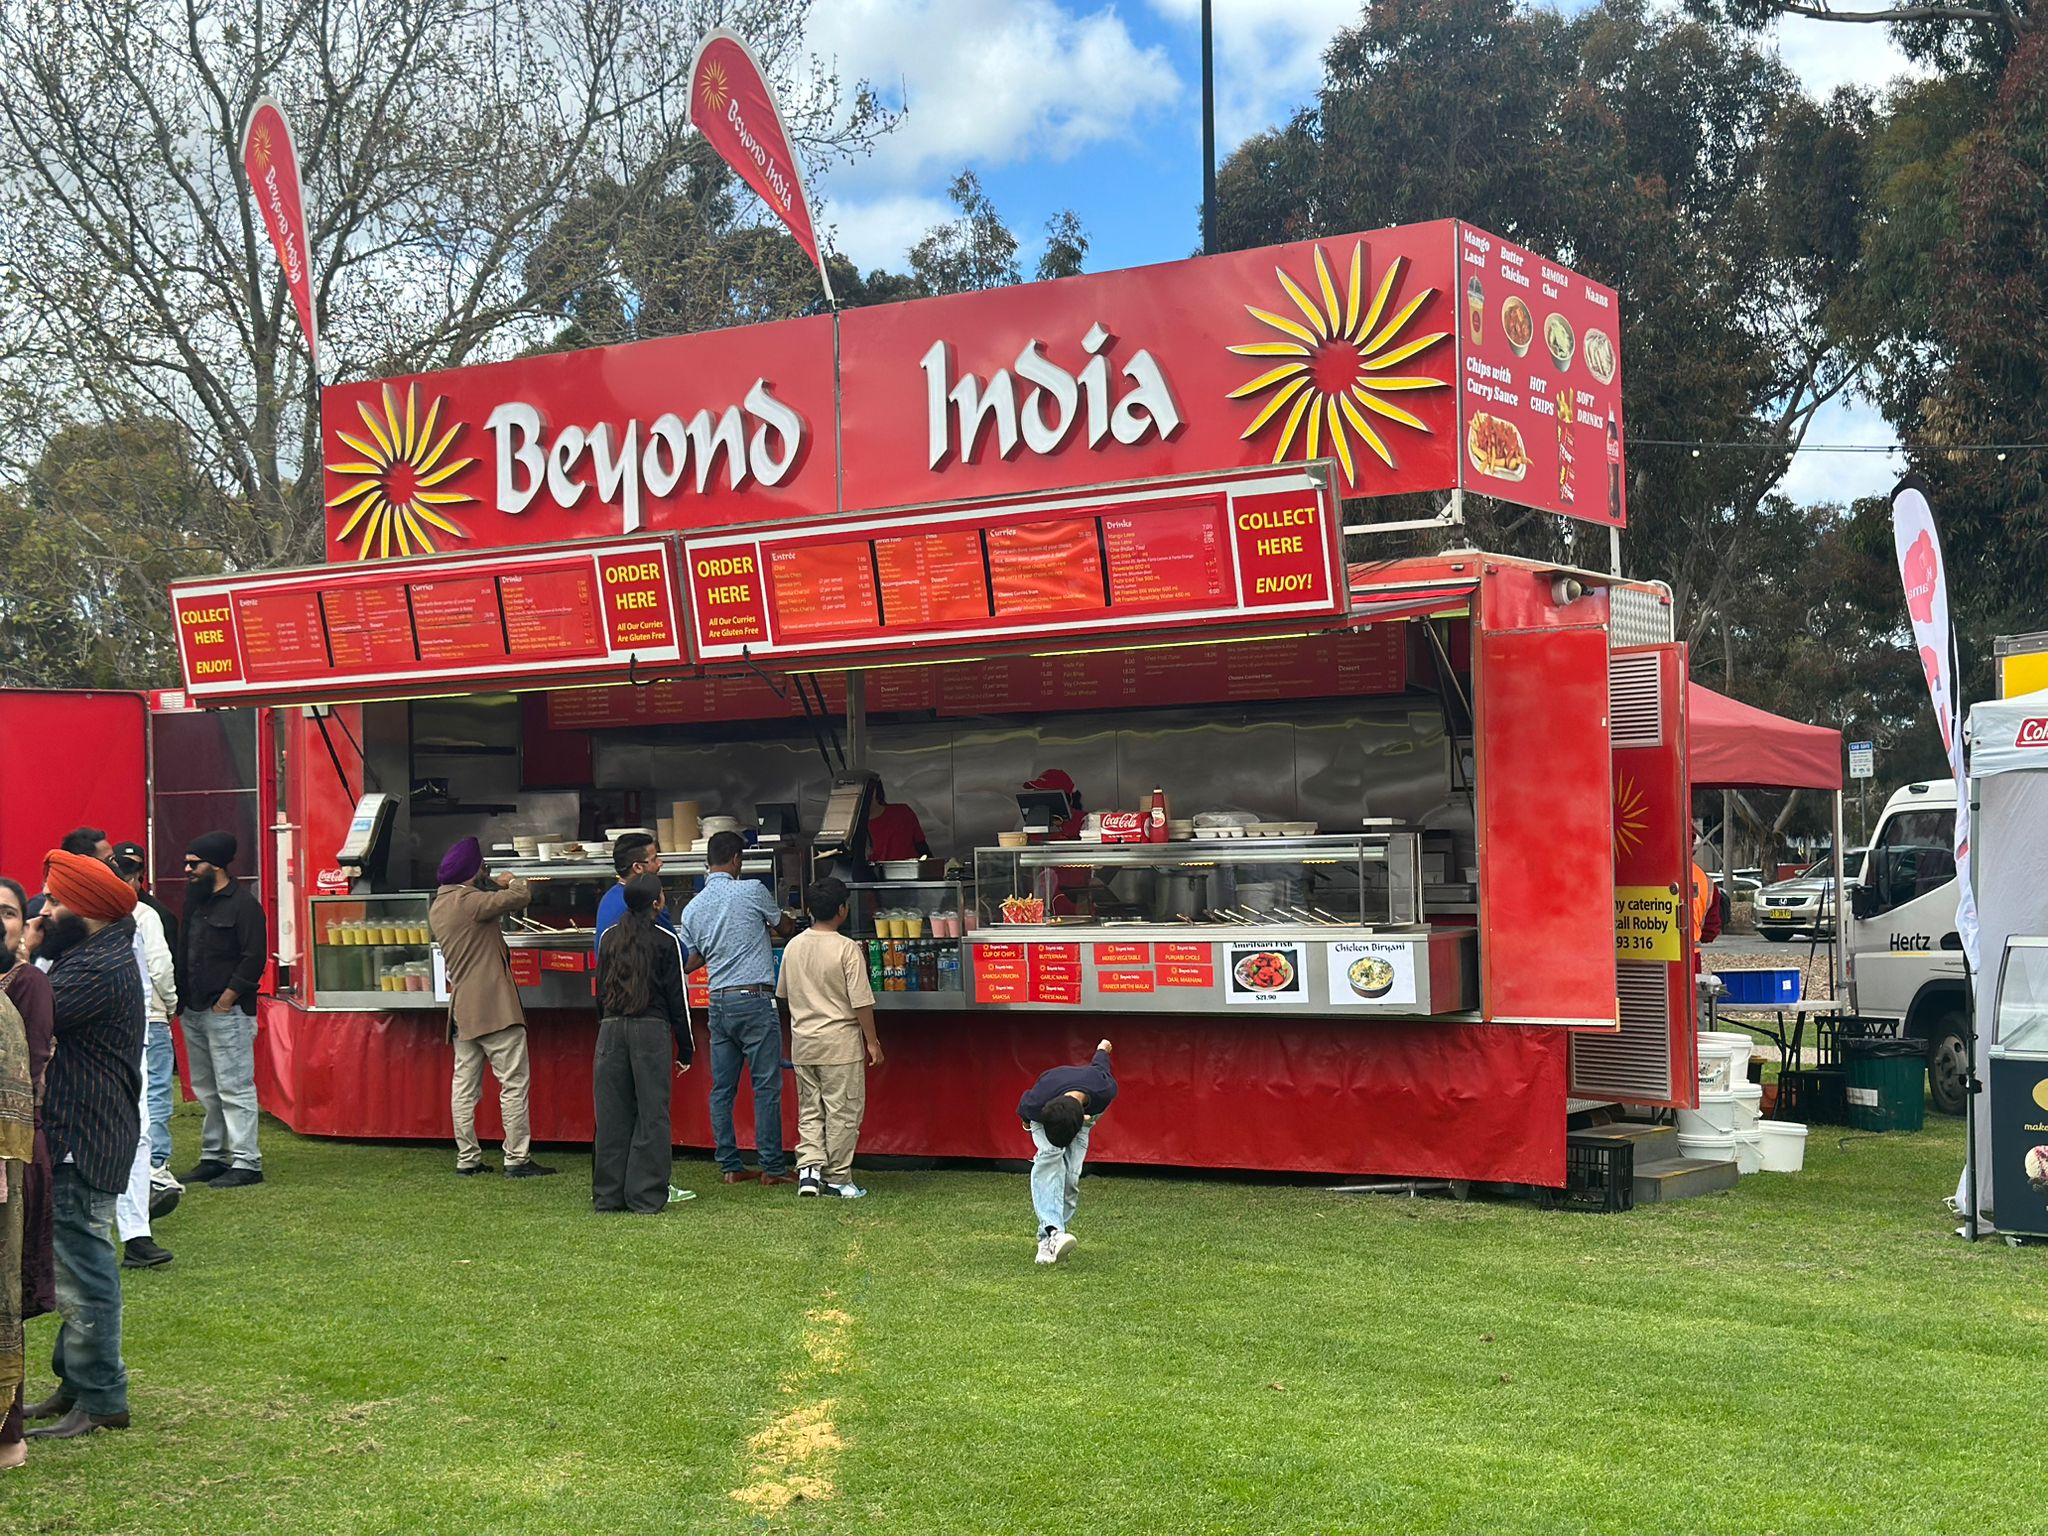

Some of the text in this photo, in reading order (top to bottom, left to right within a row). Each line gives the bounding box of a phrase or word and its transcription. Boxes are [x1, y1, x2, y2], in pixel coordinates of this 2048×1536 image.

[728, 98, 765, 166] Beyond
[765, 157, 792, 212] India
[265, 165, 288, 235] Beyond
[1464, 229, 1490, 253] Mango
[1464, 248, 1485, 268] Lassi
[1500, 246, 1524, 267] Butter
[1501, 265, 1530, 288] Chicken
[1541, 266, 1568, 288] SAMOSA
[1542, 283, 1558, 300] Chat
[1585, 286, 1609, 308] Naans
[1466, 356, 1512, 384] Chips with
[1467, 378, 1519, 407] Curry Sauce
[1529, 376, 1547, 394] HOT
[1530, 396, 1555, 416] CHIPS
[1576, 390, 1595, 408] SOFT
[484, 321, 1184, 534] Beyond India
[1577, 409, 1604, 430] DRINKS
[1106, 519, 1132, 529] Drinks
[1238, 507, 1316, 531] COLLECT
[990, 529, 1016, 538] Curries
[1257, 536, 1303, 556] HERE
[605, 563, 660, 584] ORDER
[697, 556, 754, 578] ORDER
[412, 584, 433, 592] Curries
[502, 575, 522, 584] Drinks
[1255, 573, 1313, 594] ENJOY!
[615, 591, 657, 610] HERE
[707, 584, 751, 605] HERE
[181, 608, 230, 624] COLLECT
[709, 615, 756, 627] All Our Curries
[617, 620, 664, 632] All Our Curries
[709, 626, 759, 638] Are Gluten Free
[194, 630, 224, 645] HERE
[617, 631, 666, 643] Are Gluten Free
[196, 659, 232, 674] ENJOY!
[2023, 720, 2048, 741] Col
[1628, 898, 1672, 914] catering
[1633, 917, 1668, 934] Robby
[1335, 942, 1405, 953] Chicken Biryani
[1633, 937, 1653, 949] 316
[1890, 933, 1930, 951] Hertz
